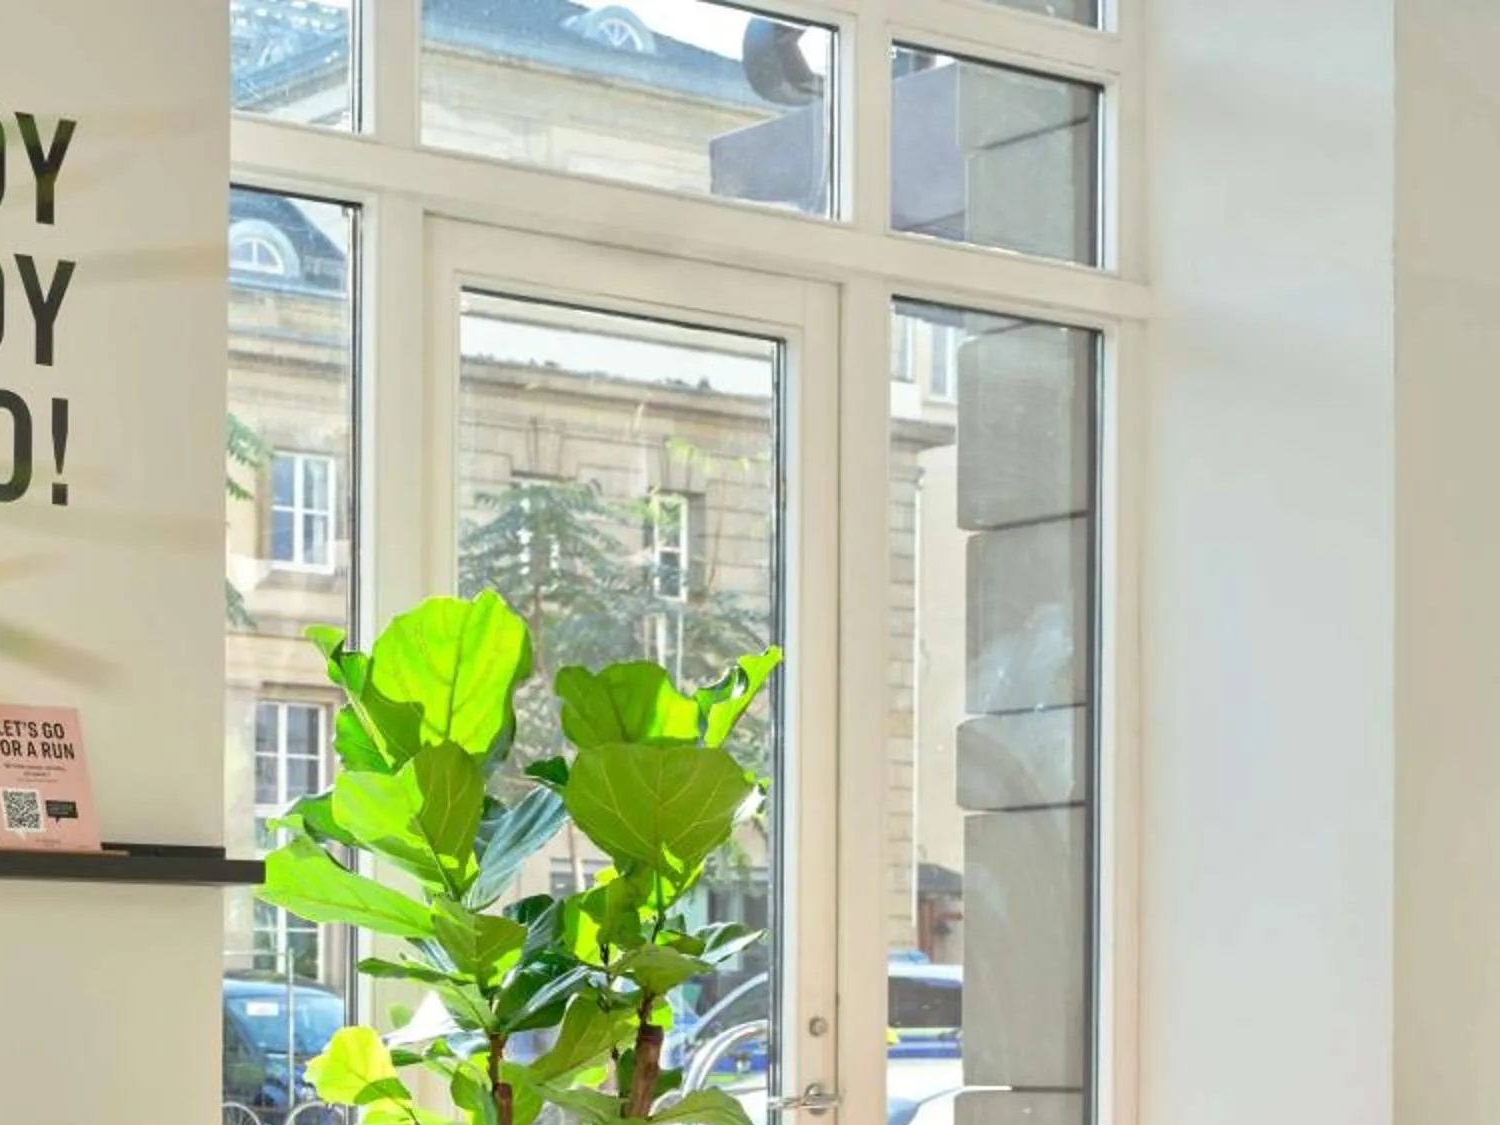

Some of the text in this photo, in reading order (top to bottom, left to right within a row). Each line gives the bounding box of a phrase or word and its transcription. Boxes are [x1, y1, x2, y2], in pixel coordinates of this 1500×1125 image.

[41, 722, 65, 739] GO
[27, 741, 37, 758] A
[41, 742, 75, 760] RUN
